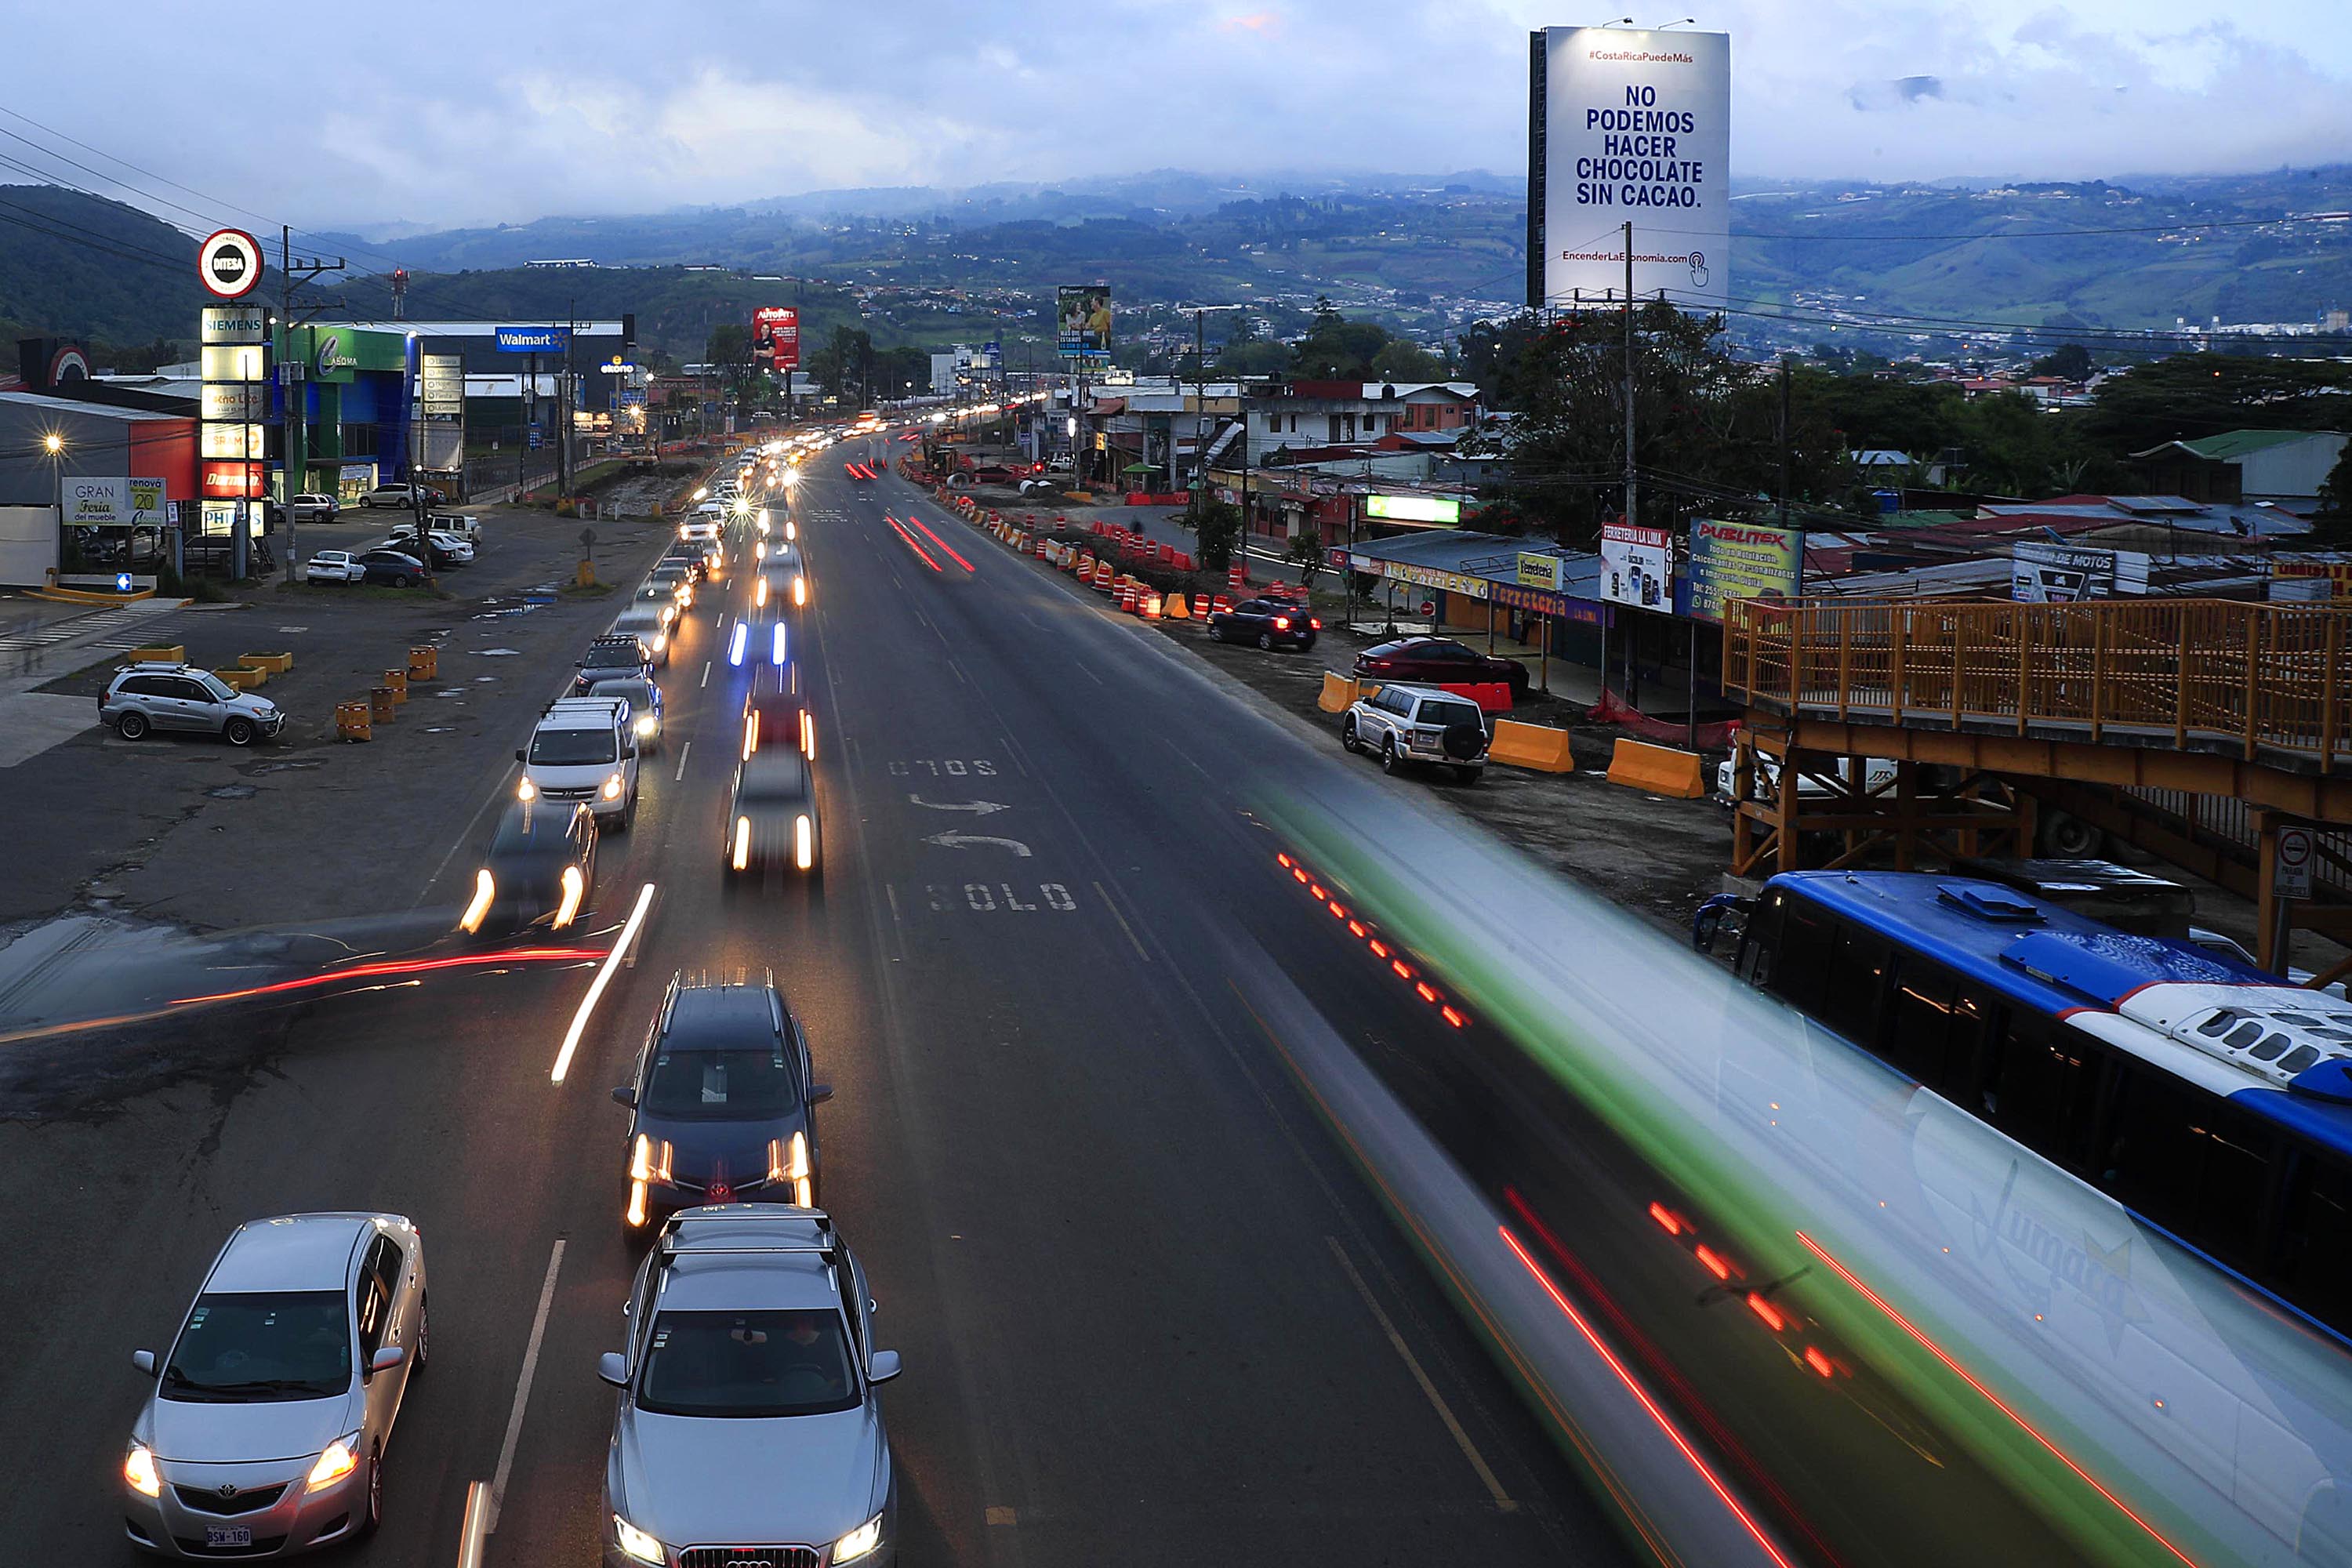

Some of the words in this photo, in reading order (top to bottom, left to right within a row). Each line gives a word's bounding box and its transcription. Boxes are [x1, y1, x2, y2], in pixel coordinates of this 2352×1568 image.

[1589, 50, 1693, 64] #CostaRicaPuedeMás
[1625, 85, 1656, 107] NO
[1586, 108, 1694, 133] PODEMOS
[1604, 134, 1677, 158] HACER
[1576, 158, 1703, 183] CHOCOLATE
[1577, 183, 1613, 205] SIN
[1621, 184, 1702, 209] CACAO.
[213, 257, 244, 270] DITESA
[1563, 251, 1688, 263] EncenderLaEonomia.com
[206, 320, 261, 330] SIEMENS
[499, 334, 550, 345] Walmart
[601, 365, 633, 373] ekono
[129, 478, 162, 488] renová
[75, 485, 114, 498] GRAN
[79, 500, 110, 512] Feria
[135, 494, 154, 510] 20
[207, 512, 260, 524] PHIS
[1639, 530, 1647, 544] LA
[1647, 531, 1662, 546] LIMA
[1699, 524, 1790, 551] PUBLITEX
[1709, 544, 1724, 555] Todo
[2055, 553, 2071, 564] DE
[2073, 555, 2112, 569] MOTOS
[208, 1531, 249, 1542] BSW-160
